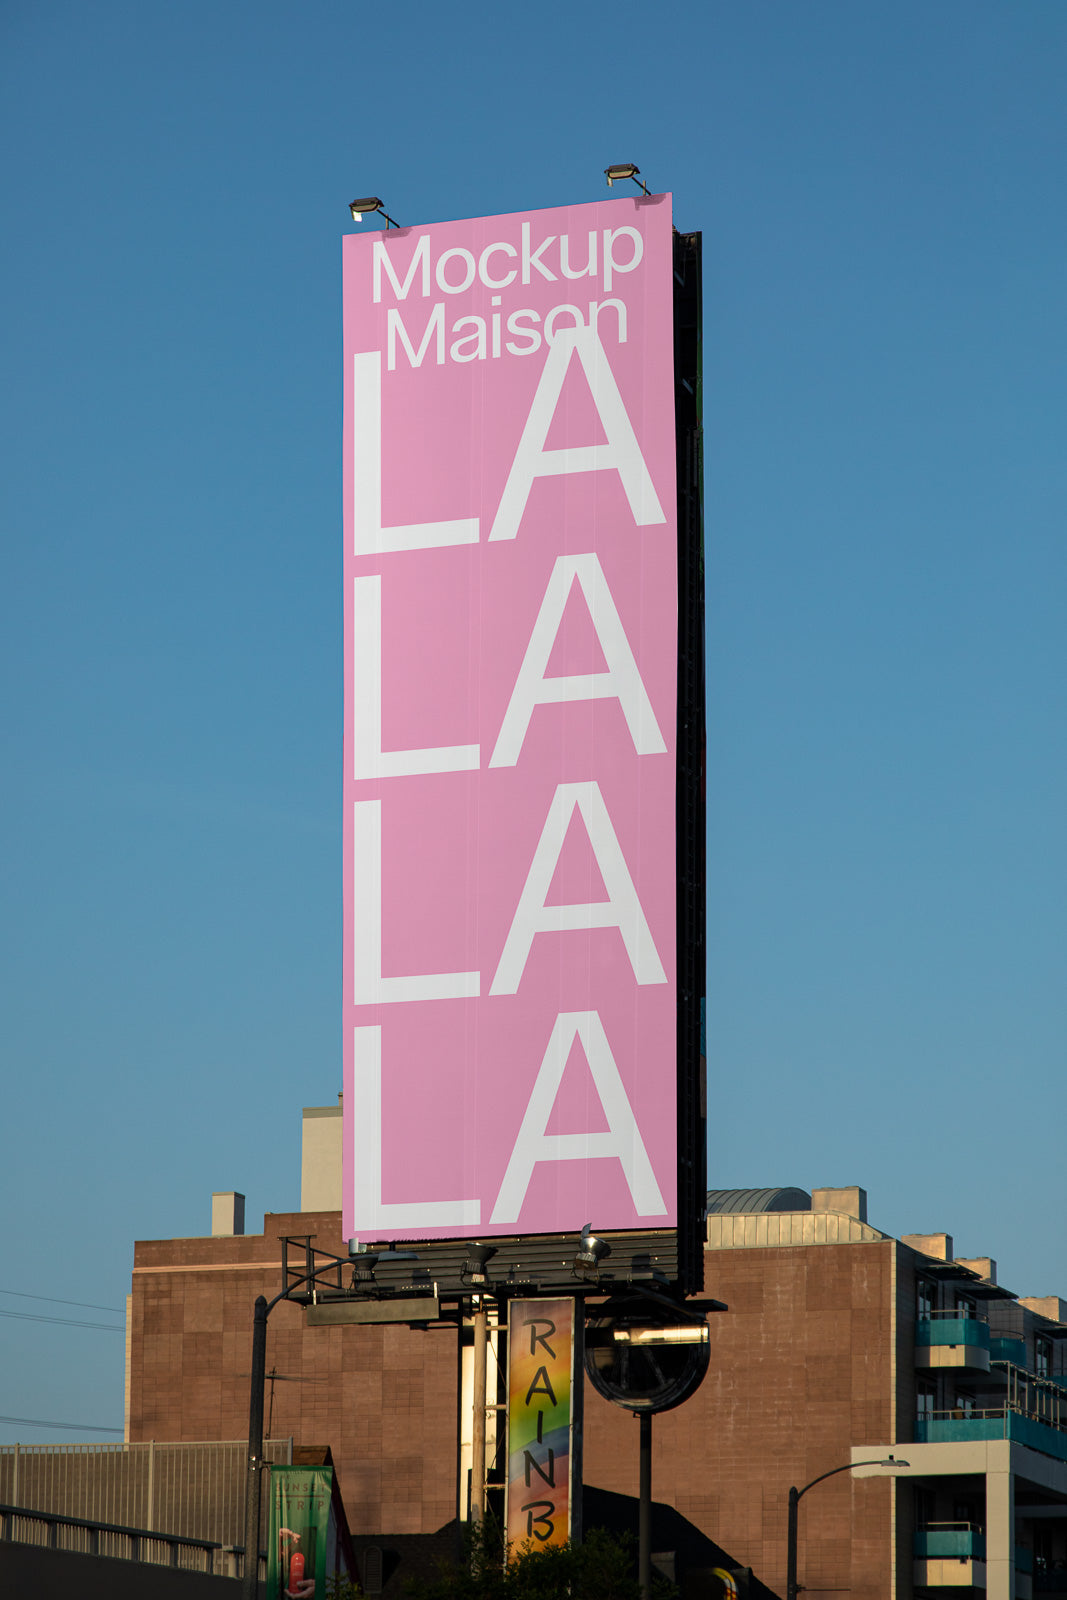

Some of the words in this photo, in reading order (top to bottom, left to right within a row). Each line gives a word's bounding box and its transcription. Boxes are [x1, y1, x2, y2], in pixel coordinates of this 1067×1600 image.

[372, 221, 645, 304] Mockup
[387, 295, 628, 371] Maison
[521, 1318, 558, 1541] RAINB
[275, 1483, 328, 1492] SUNSET
[275, 1500, 325, 1511] STRIP
